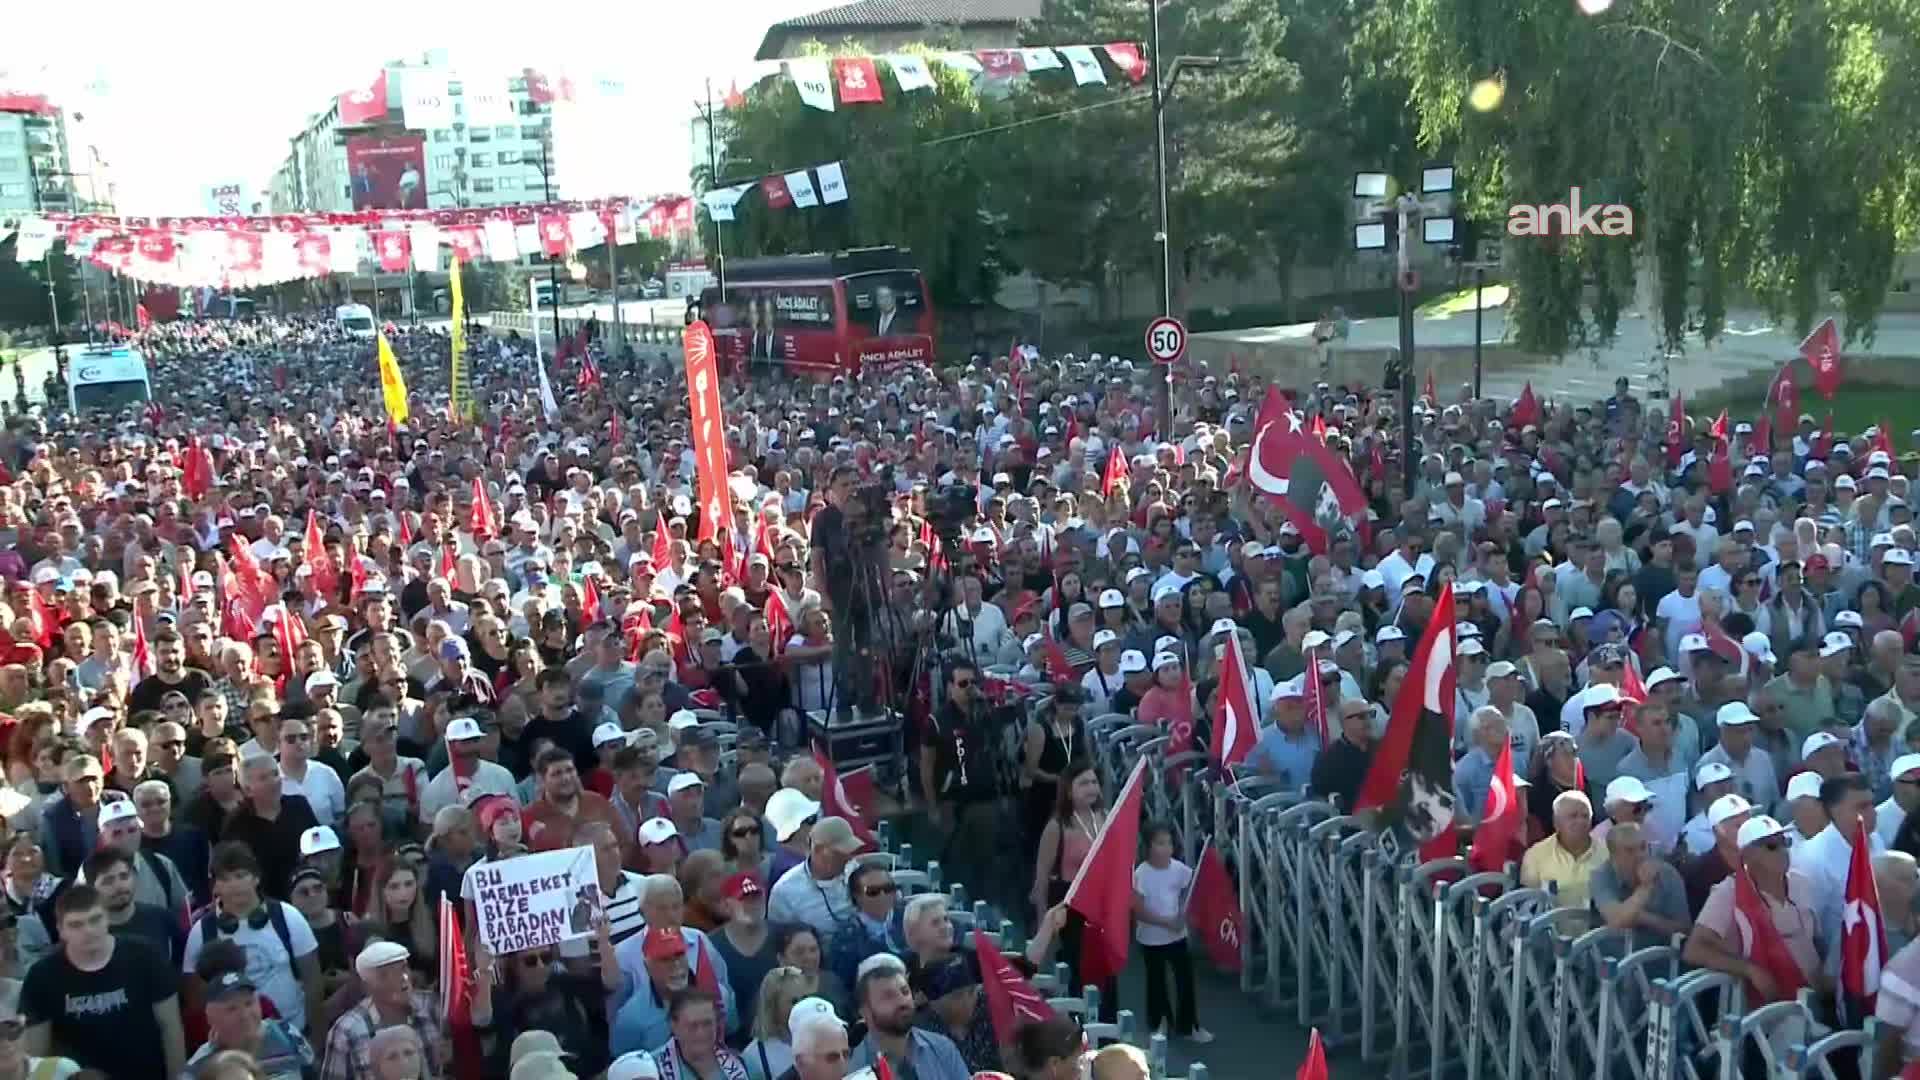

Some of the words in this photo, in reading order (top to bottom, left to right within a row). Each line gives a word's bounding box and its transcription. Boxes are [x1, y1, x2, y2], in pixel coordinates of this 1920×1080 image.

[1154, 331, 1178, 352] 50
[475, 870, 502, 888] BU
[480, 873, 572, 903] MEMLEKET
[486, 909, 565, 940] BABADAN
